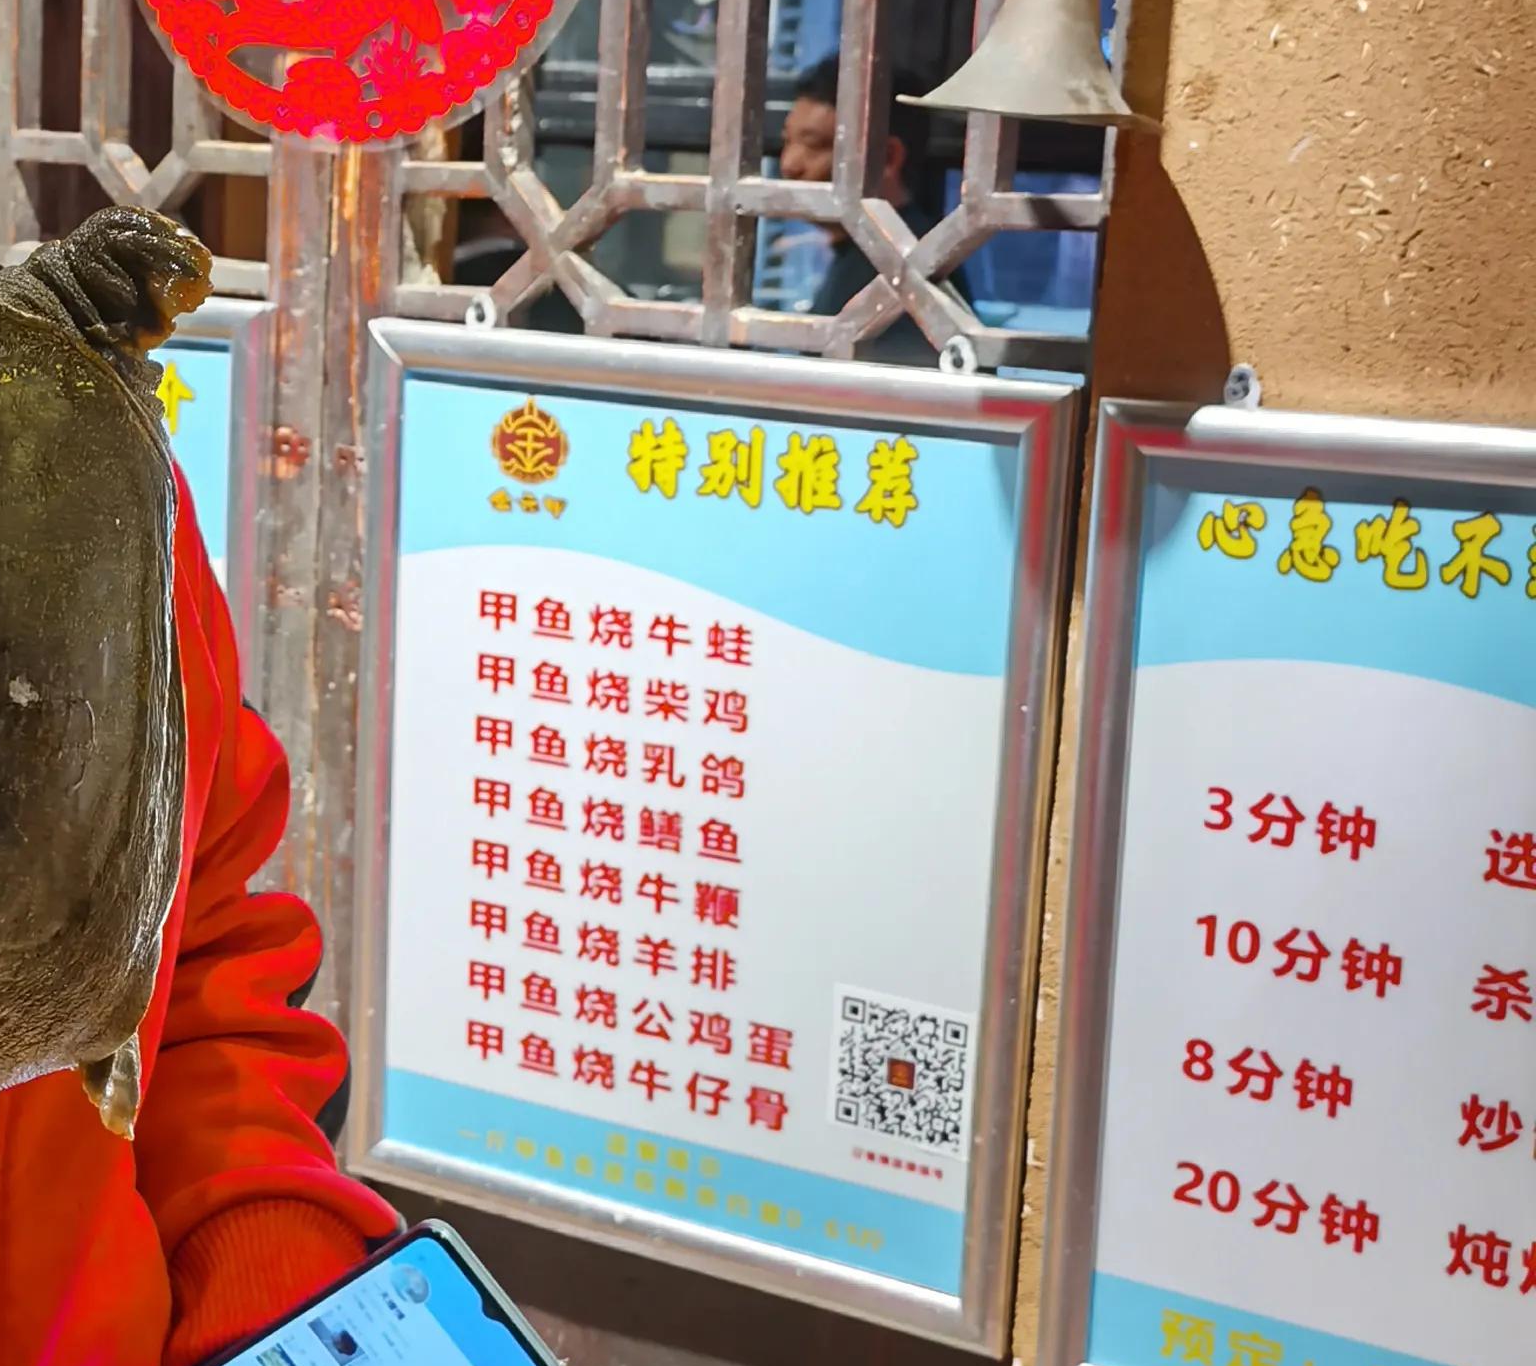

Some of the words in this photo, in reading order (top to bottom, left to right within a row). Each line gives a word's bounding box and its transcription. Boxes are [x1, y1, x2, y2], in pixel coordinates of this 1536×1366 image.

[627, 417, 920, 528] 特别推荐
[1198, 486, 1536, 599] 心急吃不
[479, 590, 753, 667] 甲鱼烧牛蛙
[478, 653, 749, 733] 甲鱼烧柴鸡
[476, 715, 745, 799] 甲鱼烧乳鸽
[474, 777, 742, 863] 甲鱼烧鳝鱼
[1203, 787, 1377, 861] 3分钟
[472, 839, 741, 930] 甲鱼烧牛鞭
[470, 899, 738, 992] 甲鱼烧羊排
[1196, 914, 1403, 998] 10分钟
[1471, 964, 1533, 1023] 杀
[469, 960, 794, 1071] 甲鱼烧公鸡蛋
[467, 1020, 789, 1132] 甲鱼烧牛仔骨
[1182, 1038, 1353, 1119] 8分钟
[1458, 1094, 1536, 1161] 炒
[1172, 1162, 1380, 1254] 20分钟
[1445, 1224, 1536, 1295] 炖
